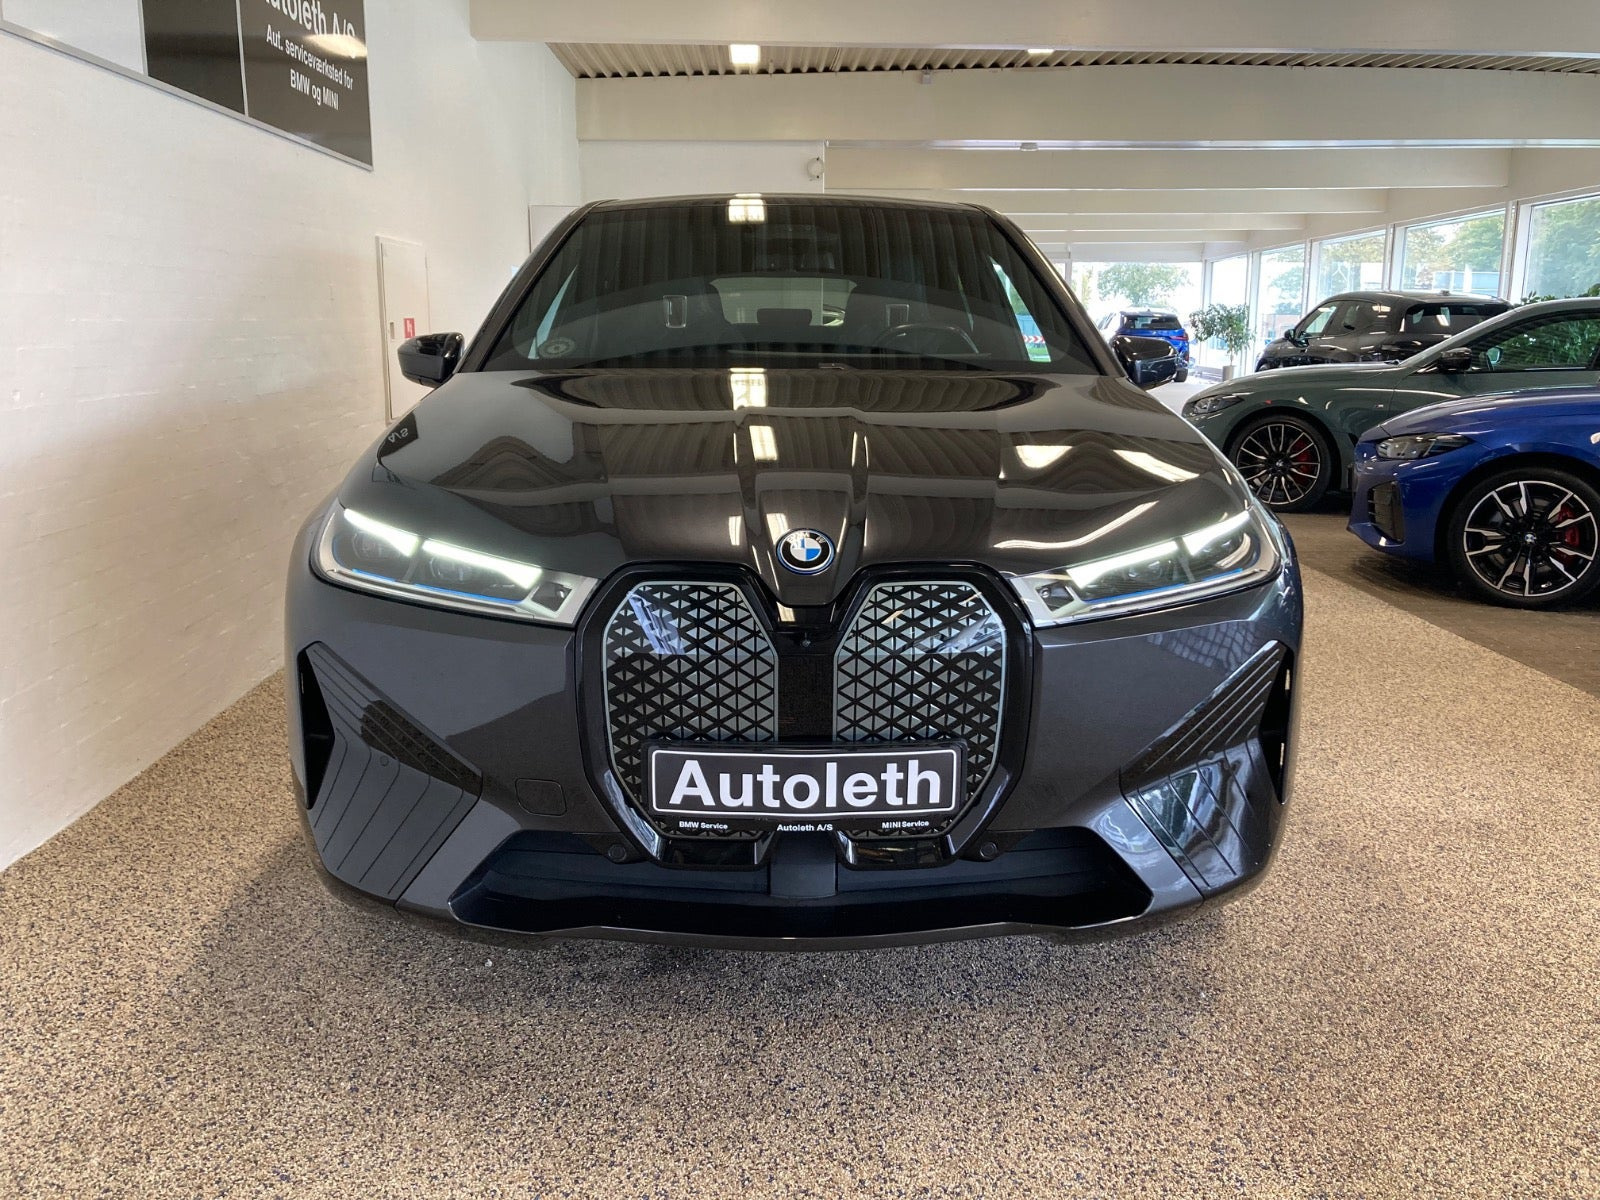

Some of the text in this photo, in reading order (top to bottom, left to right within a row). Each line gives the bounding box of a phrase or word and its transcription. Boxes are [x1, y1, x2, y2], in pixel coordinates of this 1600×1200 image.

[265, 24, 354, 90] Aut. serviceværksted for
[290, 68, 339, 111] BMW og MINI
[669, 759, 940, 808] Autoleth
[679, 820, 729, 830] BMW Service
[776, 823, 834, 832] Autoleth A/S
[881, 820, 930, 829] MINI Service
